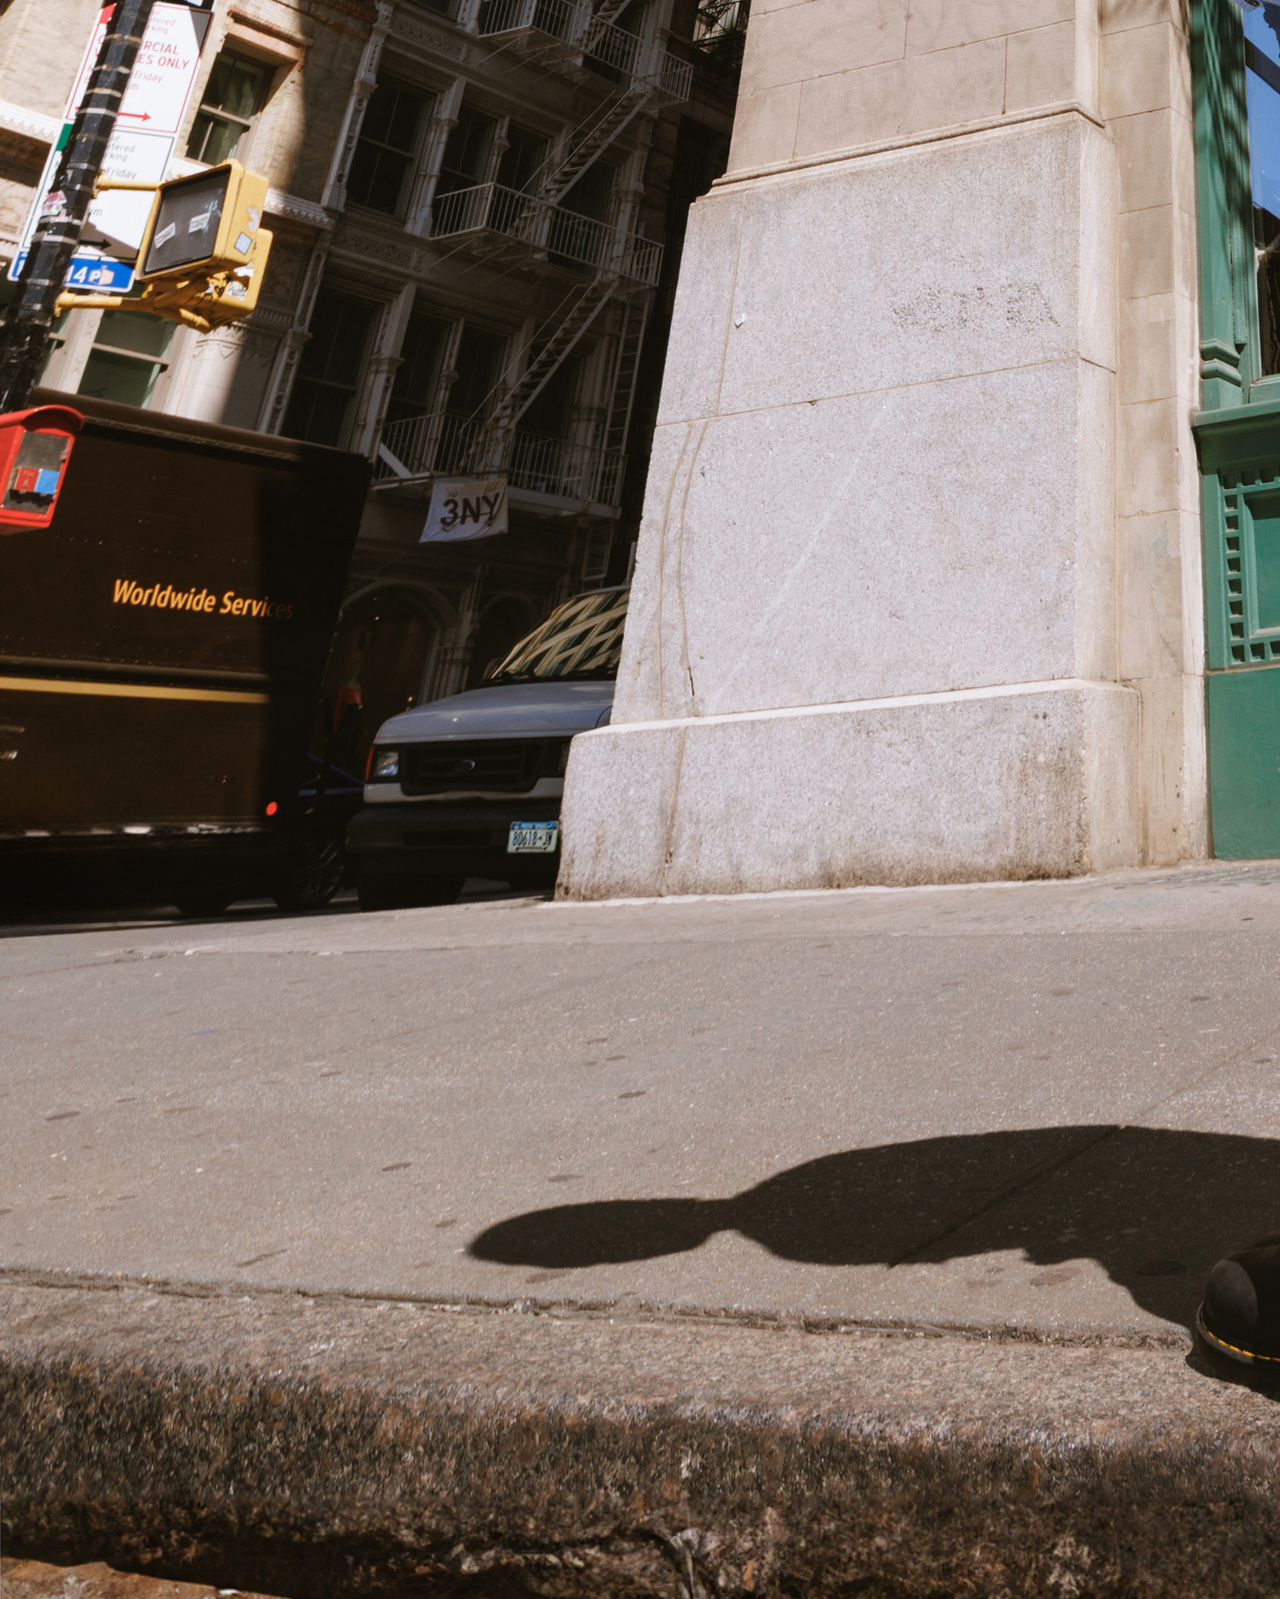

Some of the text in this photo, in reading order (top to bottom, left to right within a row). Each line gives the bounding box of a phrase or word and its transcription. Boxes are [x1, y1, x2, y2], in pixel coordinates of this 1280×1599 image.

[157, 56, 190, 70] ONLY
[440, 492, 500, 527] 3NY
[113, 578, 294, 619] Worldwide Services
